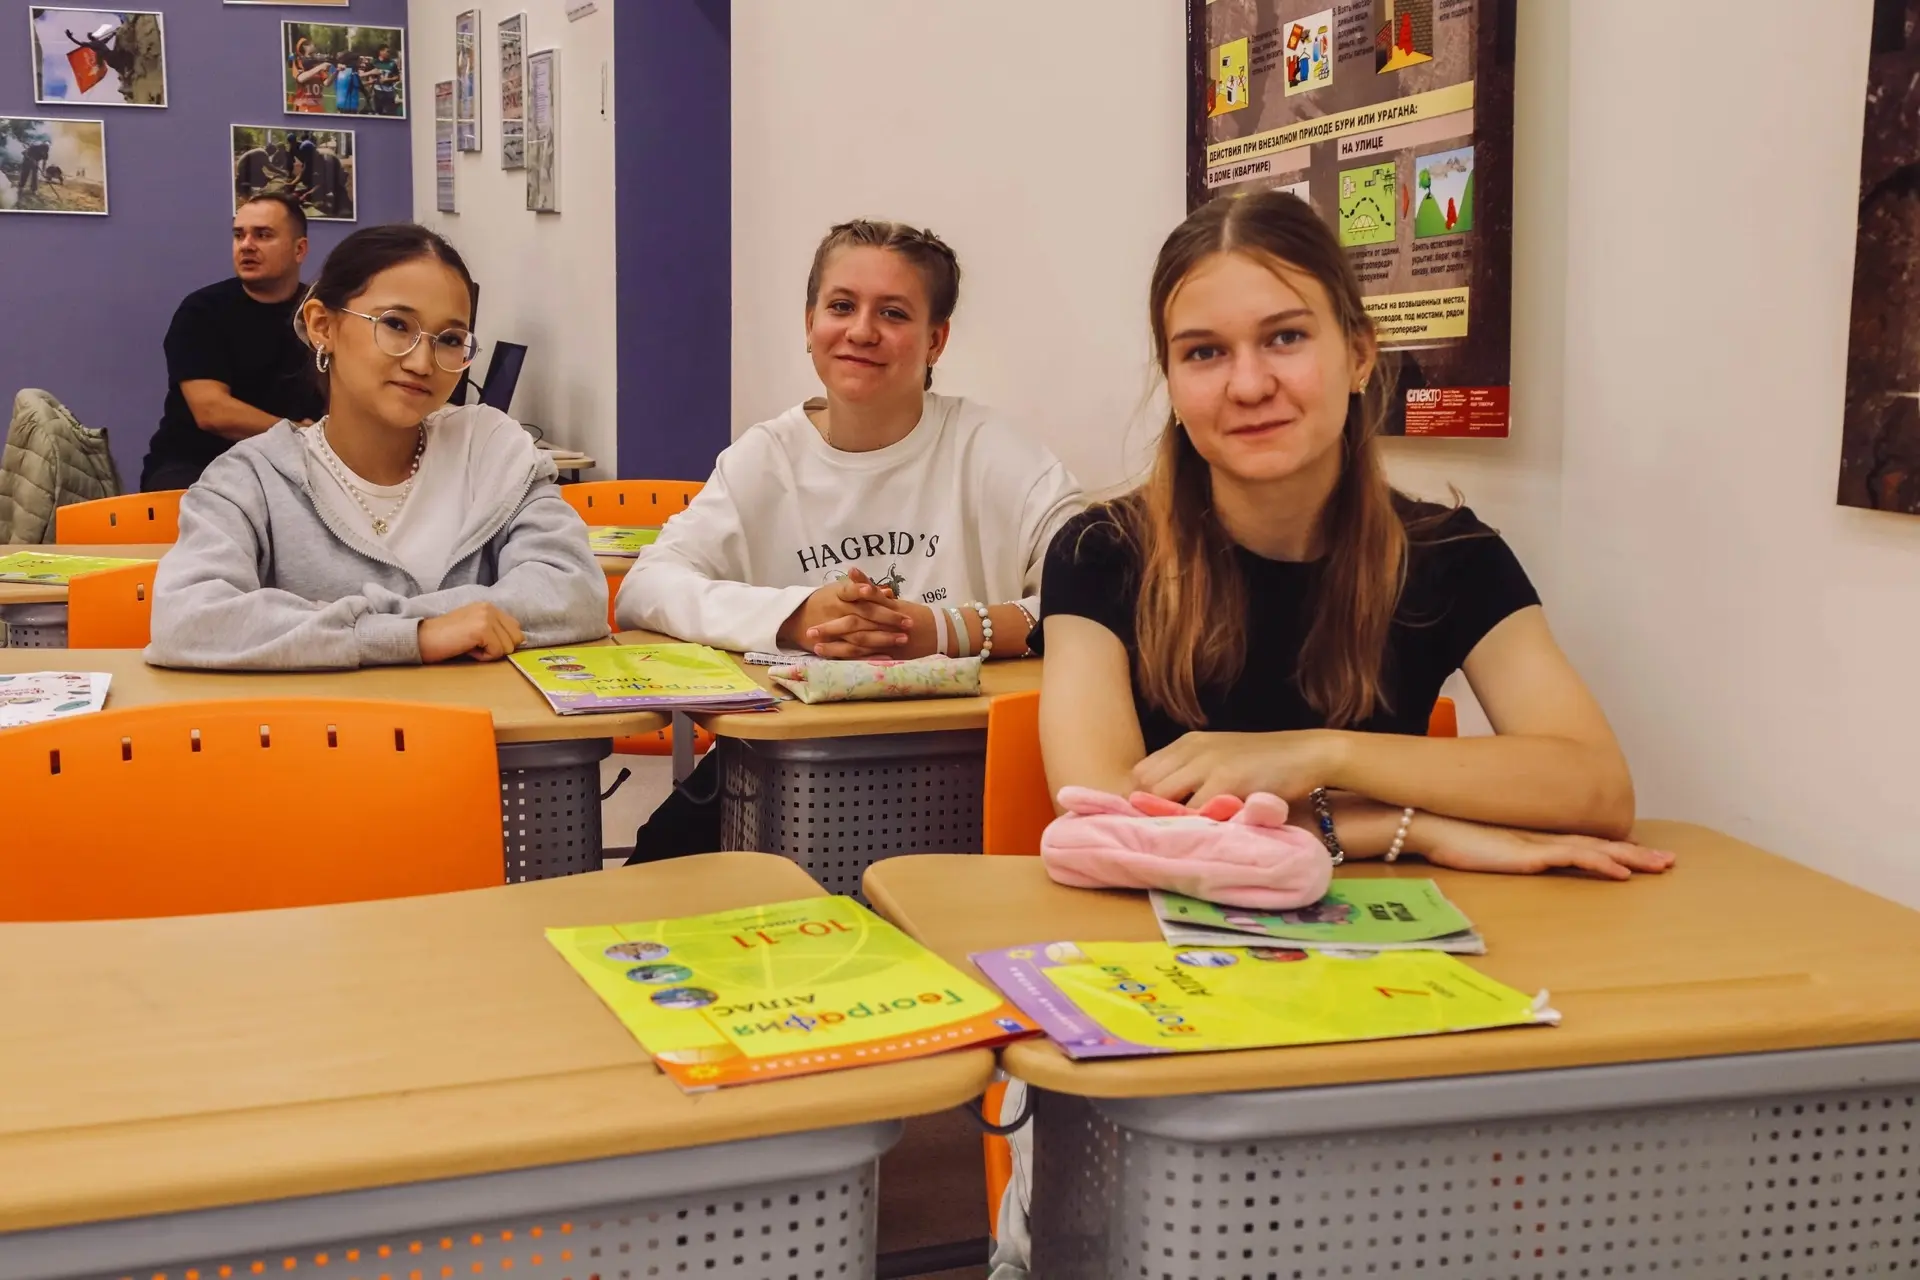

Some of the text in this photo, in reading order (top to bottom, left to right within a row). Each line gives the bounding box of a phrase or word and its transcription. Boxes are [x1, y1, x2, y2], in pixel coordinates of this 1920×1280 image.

[304, 83, 320, 96] 10
[1209, 103, 1418, 163] ДЕЙСТВИЯ ПРИ ВНЕЗАПНОМ ПРИХОДЕ БУРИ ИЛИ УРАГАНА:
[1342, 136, 1383, 154] НА УЛИЦЕ
[1209, 160, 1271, 183] В ДОМЕ (КВАРТИРЕ)
[1389, 301, 1397, 309] на
[1398, 299, 1441, 309] возвышенных
[1443, 295, 1466, 304] местах,
[1404, 312, 1415, 322] под
[1416, 310, 1444, 320] мостами,
[1446, 308, 1464, 319] рядом
[796, 531, 940, 574] HAGRID'S
[922, 587, 948, 604] 1962
[1154, 965, 1214, 997] АТЛАС
[712, 993, 815, 1017] АТЛАС
[733, 987, 964, 1036] География
[1100, 965, 1203, 1037] География
